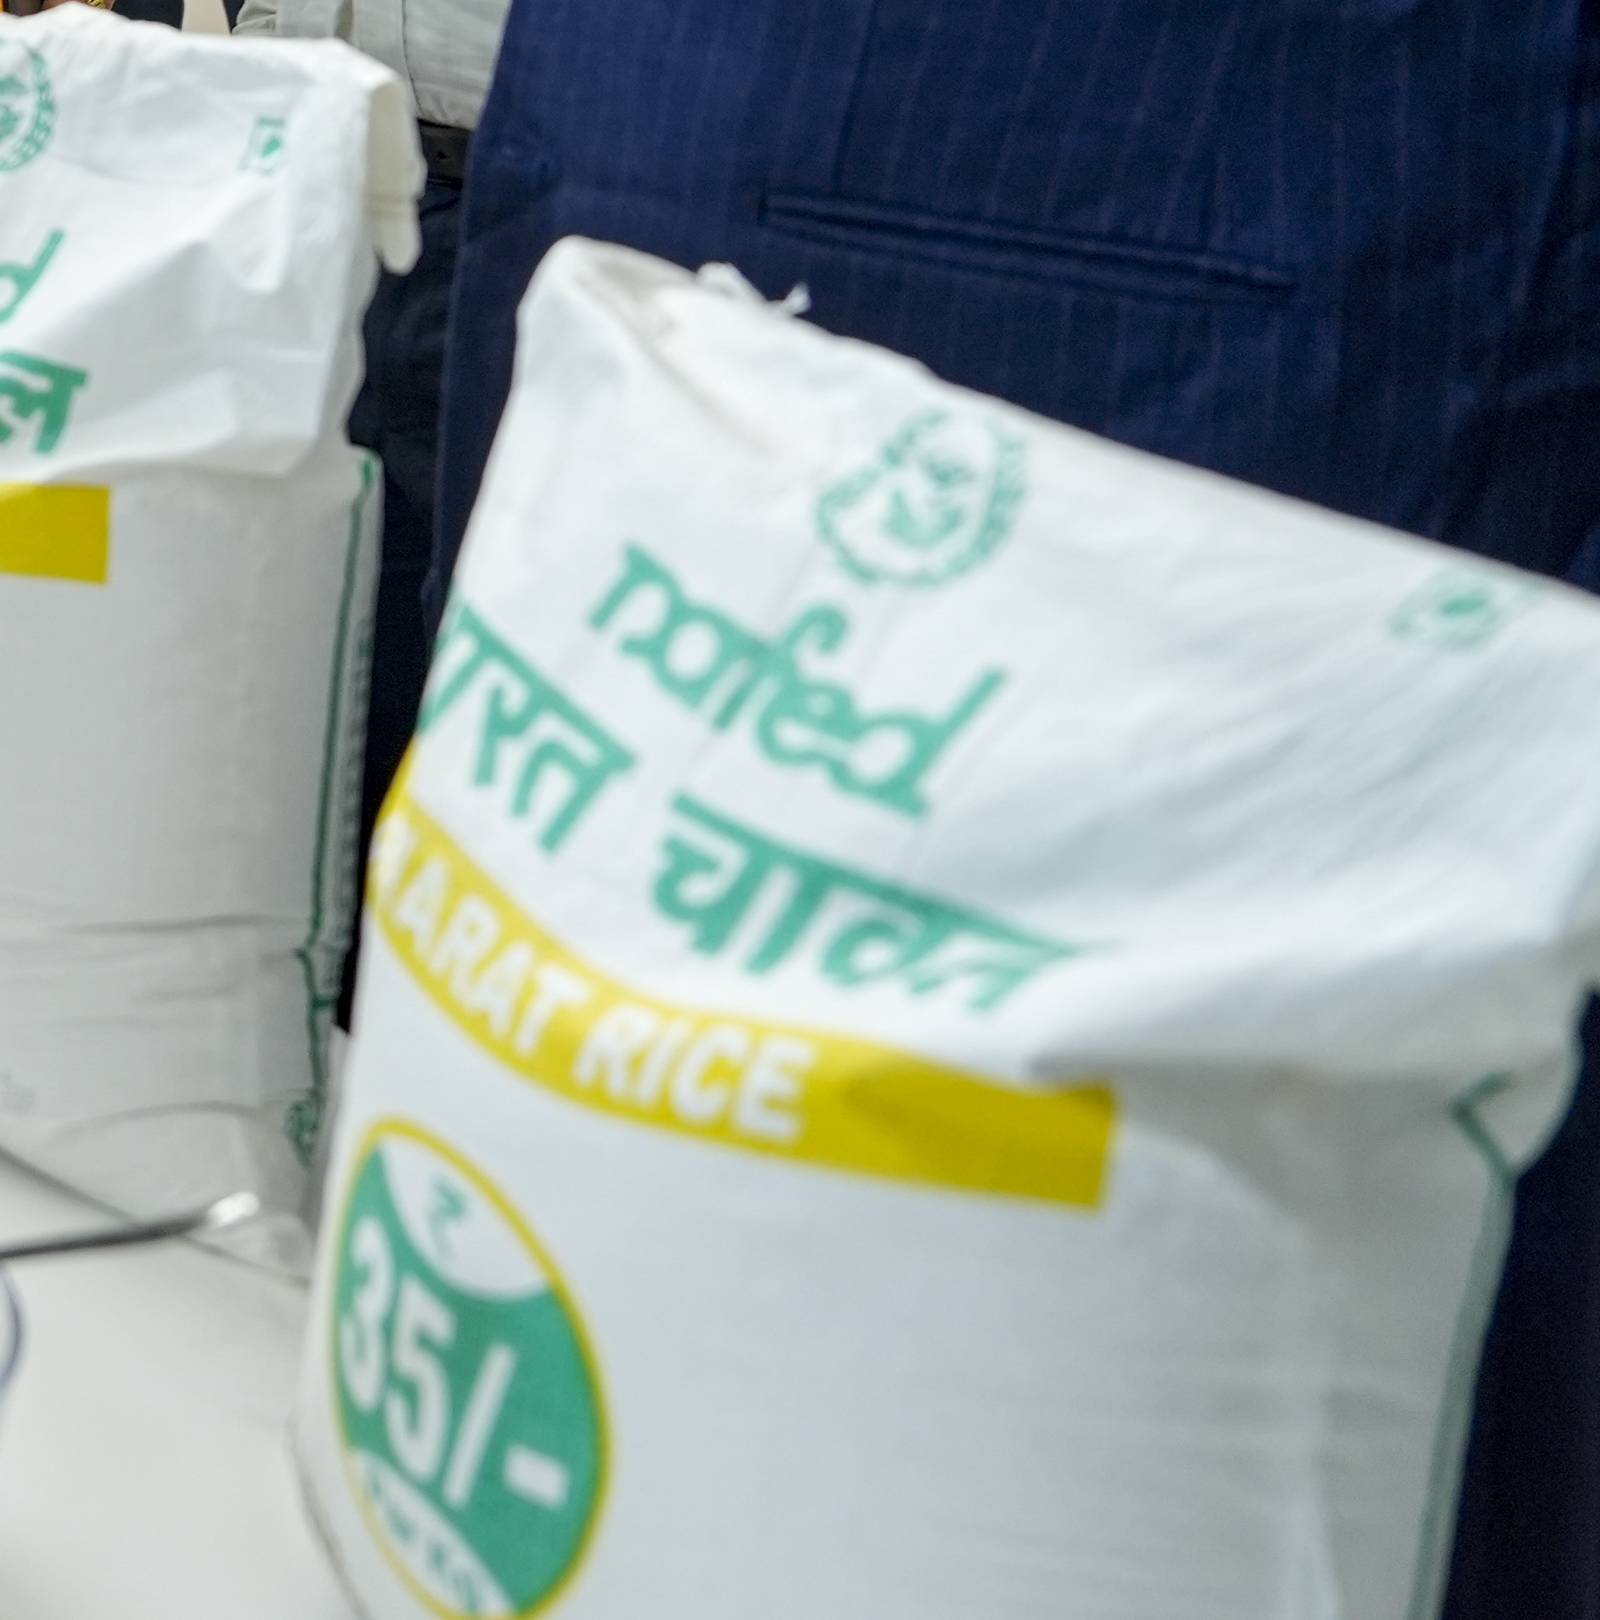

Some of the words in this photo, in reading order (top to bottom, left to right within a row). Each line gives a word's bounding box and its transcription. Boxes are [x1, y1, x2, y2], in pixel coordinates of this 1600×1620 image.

[588, 538, 1008, 820] nafed
[571, 998, 820, 1144] RICE
[339, 1214, 572, 1514] 35/-
